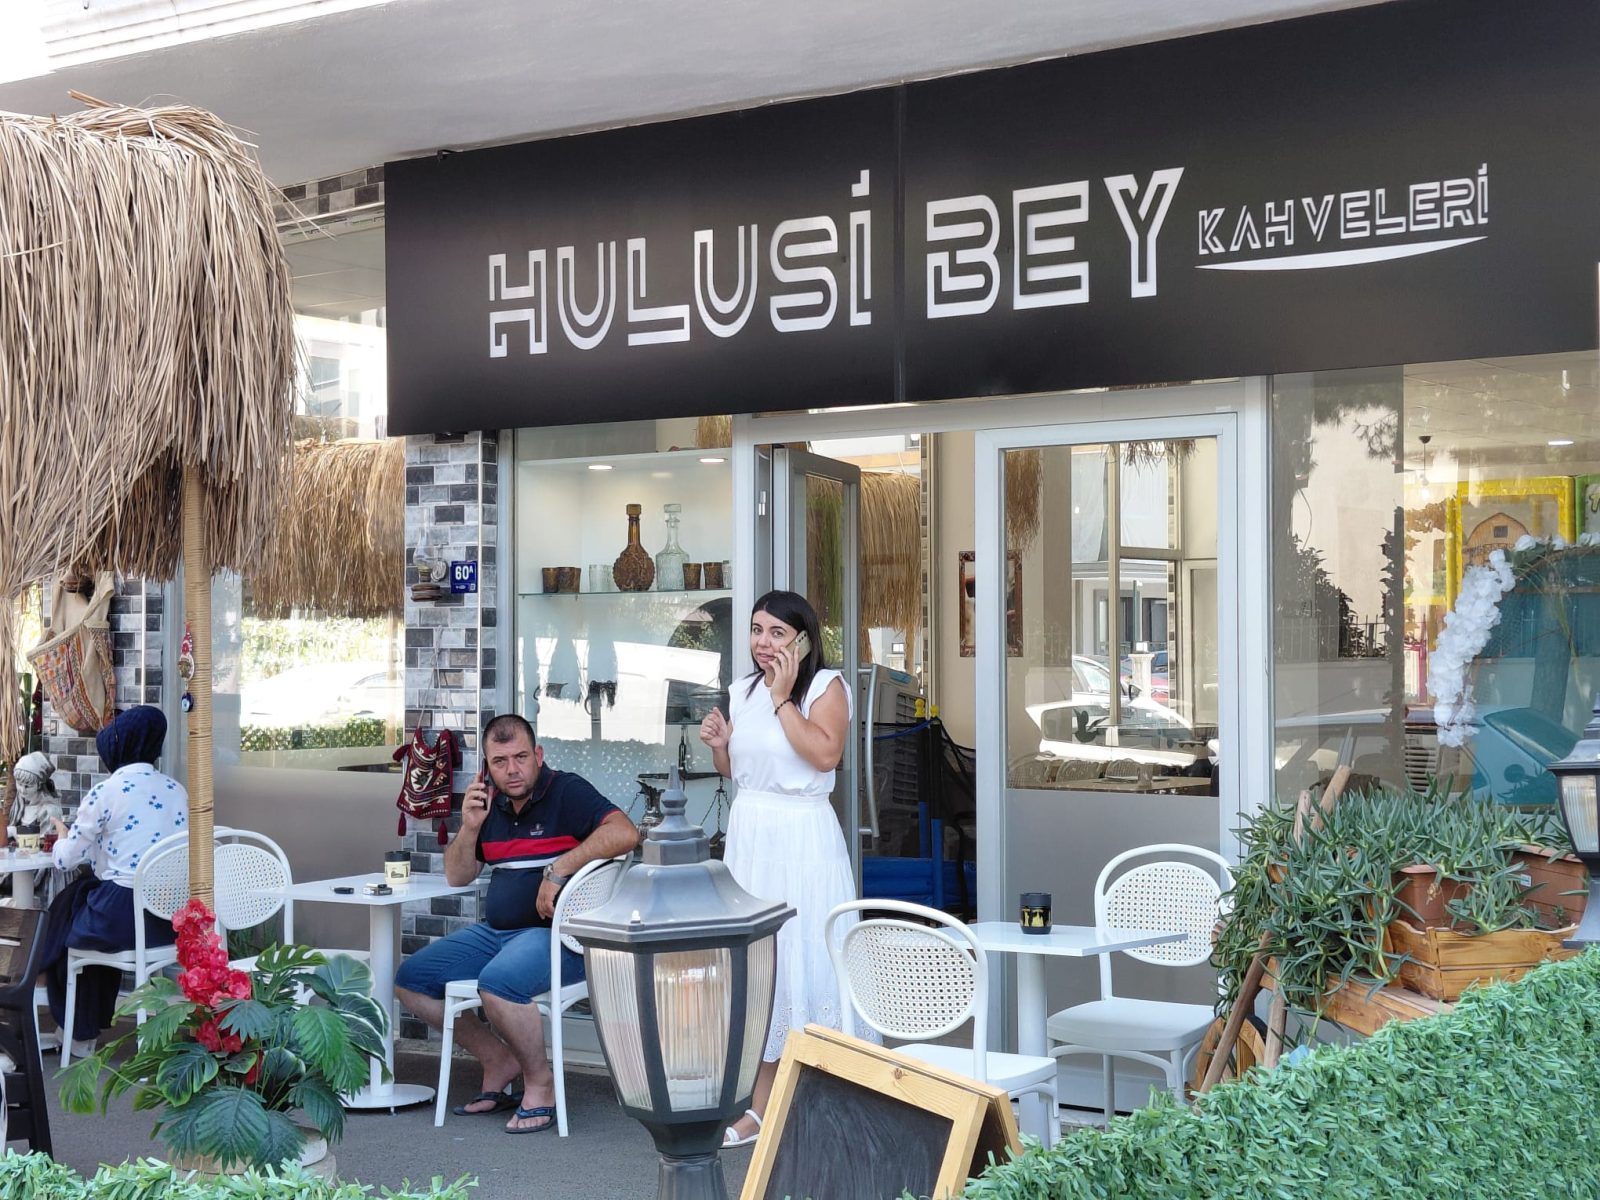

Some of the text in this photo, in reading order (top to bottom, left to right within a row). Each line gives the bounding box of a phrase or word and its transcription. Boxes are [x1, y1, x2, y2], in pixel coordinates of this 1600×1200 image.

[488, 162, 1489, 359] HULUSİ BEY KAHVELERİ
